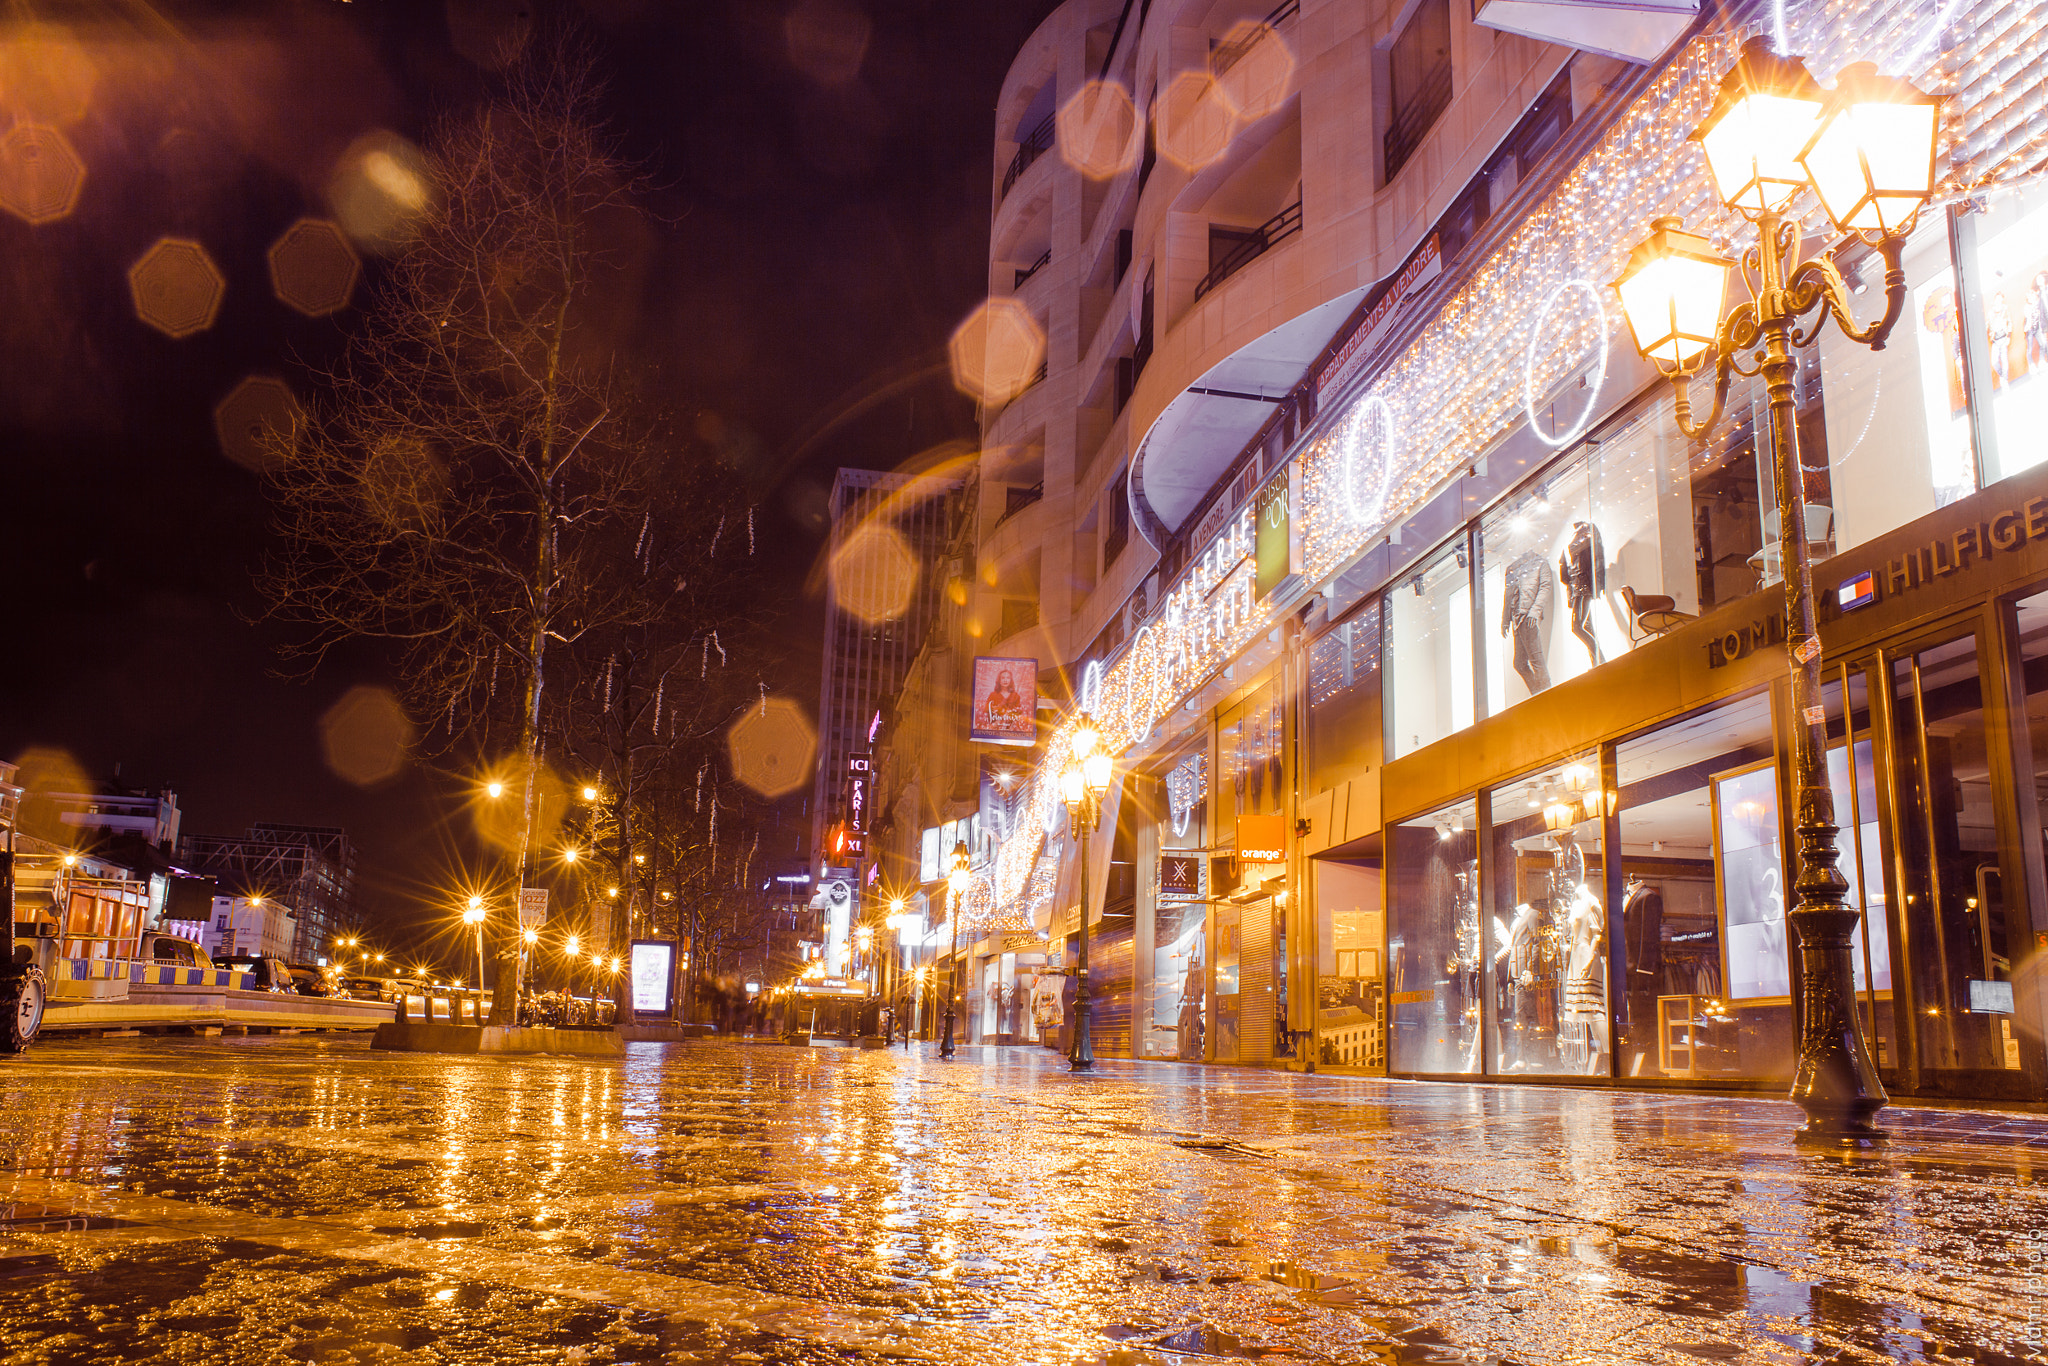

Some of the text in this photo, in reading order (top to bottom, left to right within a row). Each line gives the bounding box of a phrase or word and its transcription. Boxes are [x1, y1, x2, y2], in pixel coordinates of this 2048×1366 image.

[1319, 305, 1386, 390] APPARTEMENTS
[1392, 241, 1434, 299] VENDRE
[1257, 463, 1288, 511] TOISON
[1265, 488, 1290, 529] D'OR
[1199, 502, 1225, 543] VENDRE
[1166, 507, 1250, 628] GALERIE
[850, 759, 869, 771] ICI
[852, 780, 863, 831] PARIS
[847, 840, 863, 851] XL
